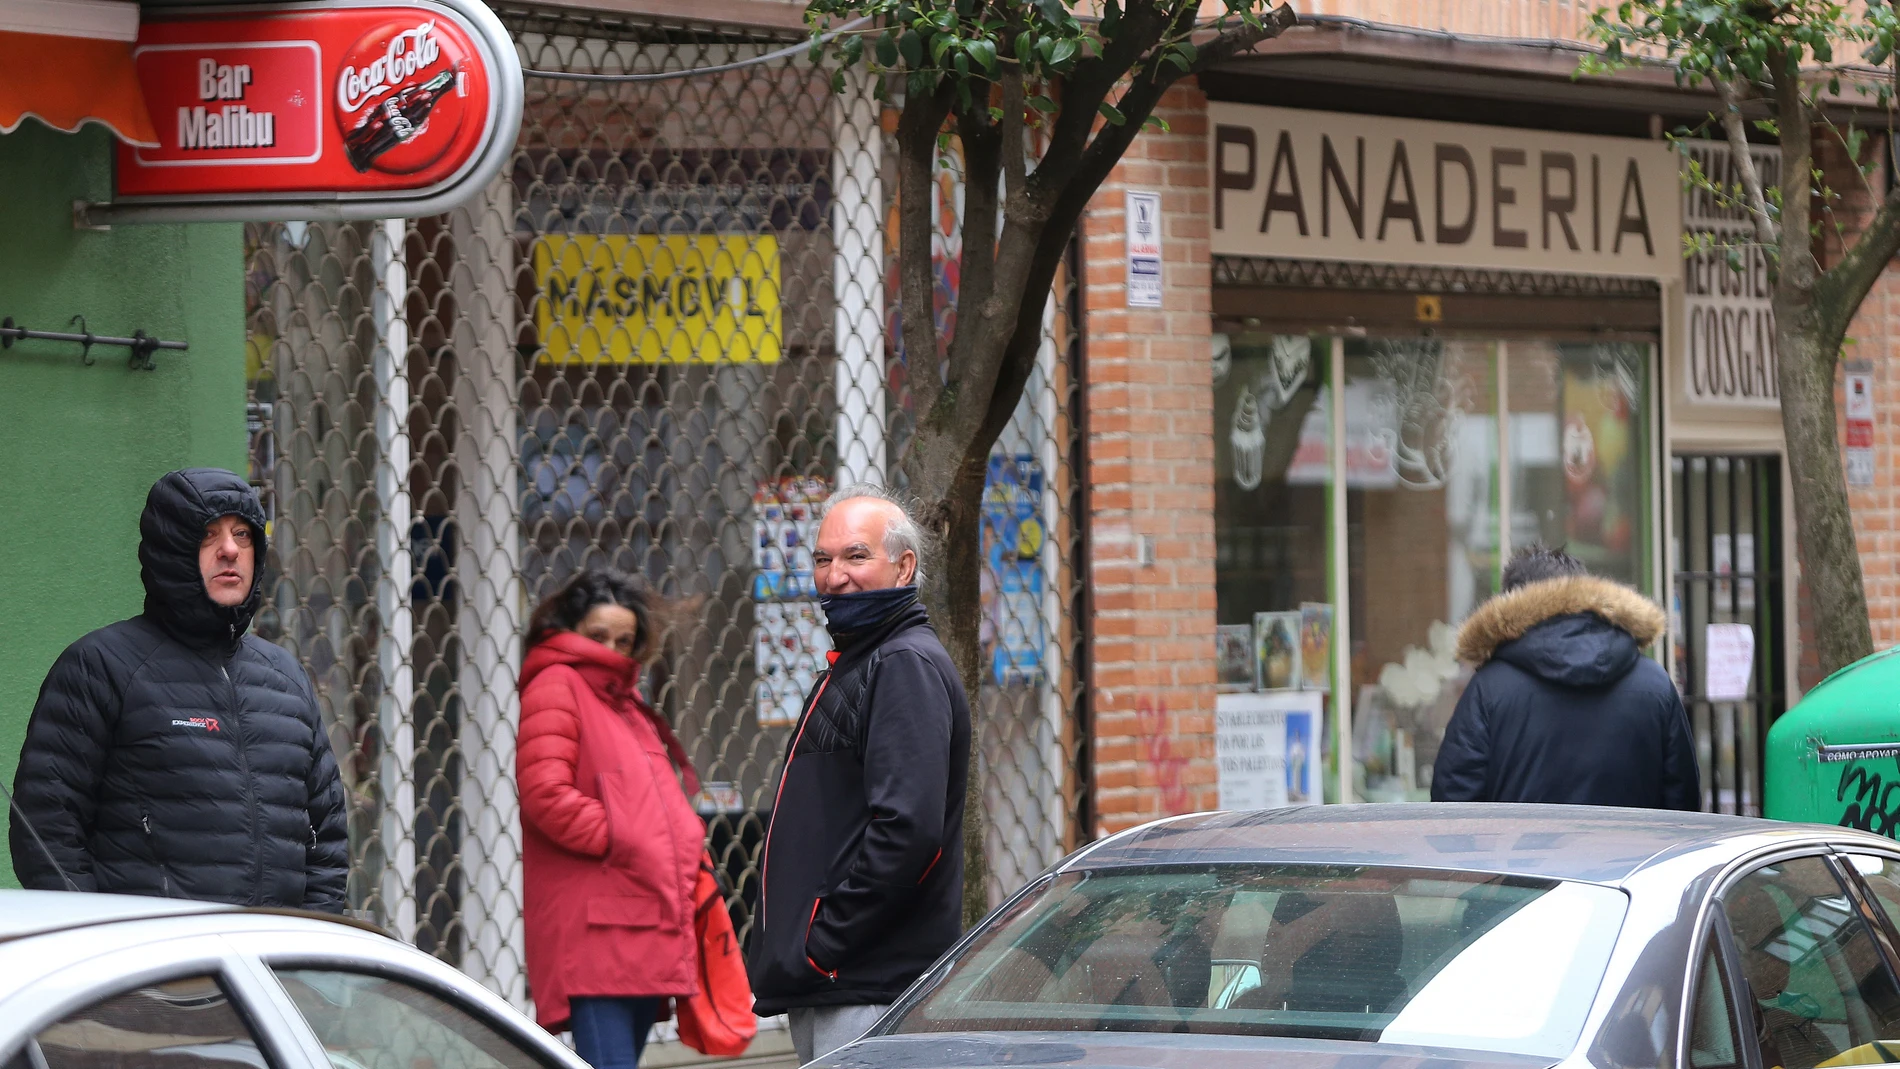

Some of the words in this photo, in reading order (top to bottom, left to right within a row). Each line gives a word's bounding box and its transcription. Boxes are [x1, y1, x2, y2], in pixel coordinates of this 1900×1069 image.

[199, 57, 252, 100] Bar
[177, 104, 274, 149] Malibu
[1214, 123, 1656, 256] PANADERIA
[1827, 750, 1858, 762] COMO
